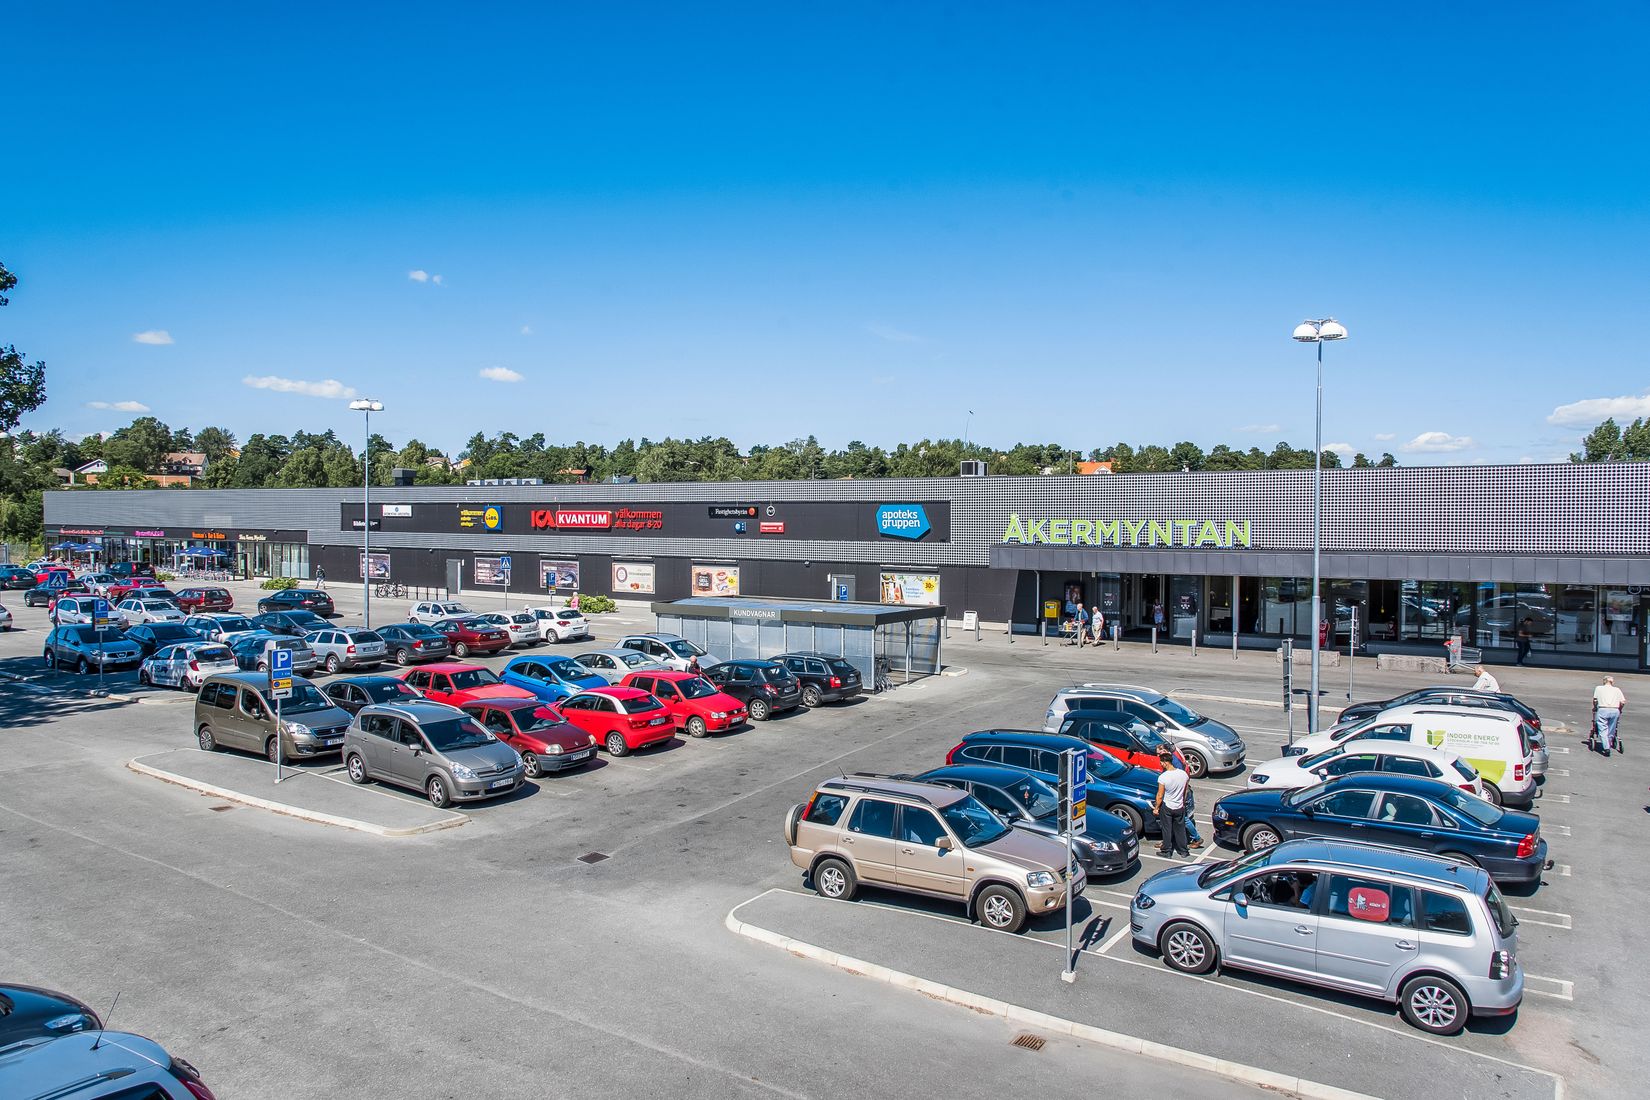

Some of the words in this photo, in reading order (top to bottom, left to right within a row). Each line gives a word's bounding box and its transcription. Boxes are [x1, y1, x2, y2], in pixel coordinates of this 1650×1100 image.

[530, 510, 556, 528] ICA
[558, 513, 608, 525] KVANTUM
[614, 507, 663, 519] välkommen
[881, 509, 918, 521] apoteks
[614, 519, 626, 528] alla
[627, 519, 646, 531] dagar
[881, 518, 921, 530] gruppen
[1002, 512, 1251, 548] ÅKERMYNTAN
[841, 585, 847, 594] P
[98, 600, 106, 611] P
[733, 608, 776, 618] KUNDVAGNAR
[277, 651, 289, 668] P
[1447, 732, 1472, 740] INDOOR
[1076, 755, 1085, 782] P
